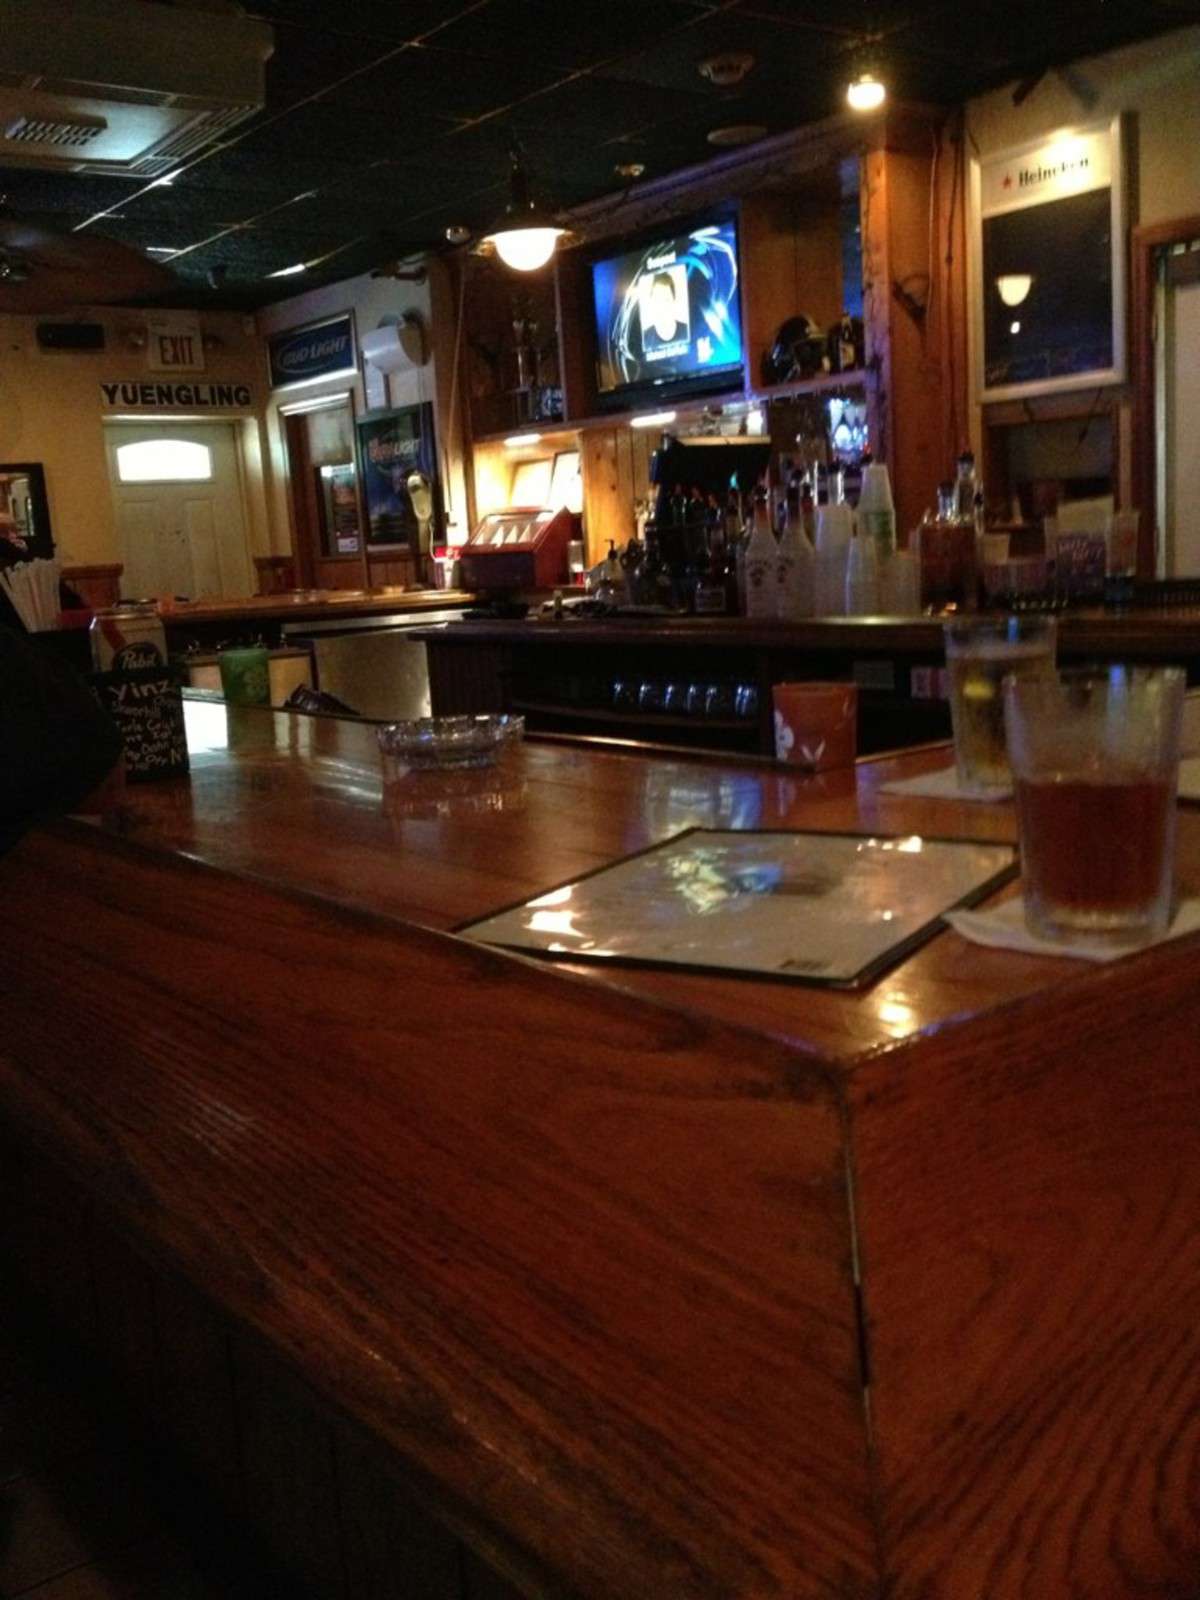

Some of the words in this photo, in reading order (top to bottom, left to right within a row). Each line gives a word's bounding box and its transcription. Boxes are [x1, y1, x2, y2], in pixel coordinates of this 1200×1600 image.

[1018, 158, 1089, 188] Heinen
[158, 334, 194, 365] EXIT
[309, 335, 349, 359] LIGHT
[101, 384, 251, 406] YUENGLING
[121, 650, 157, 670] Pabst
[108, 680, 172, 701] Yinz
